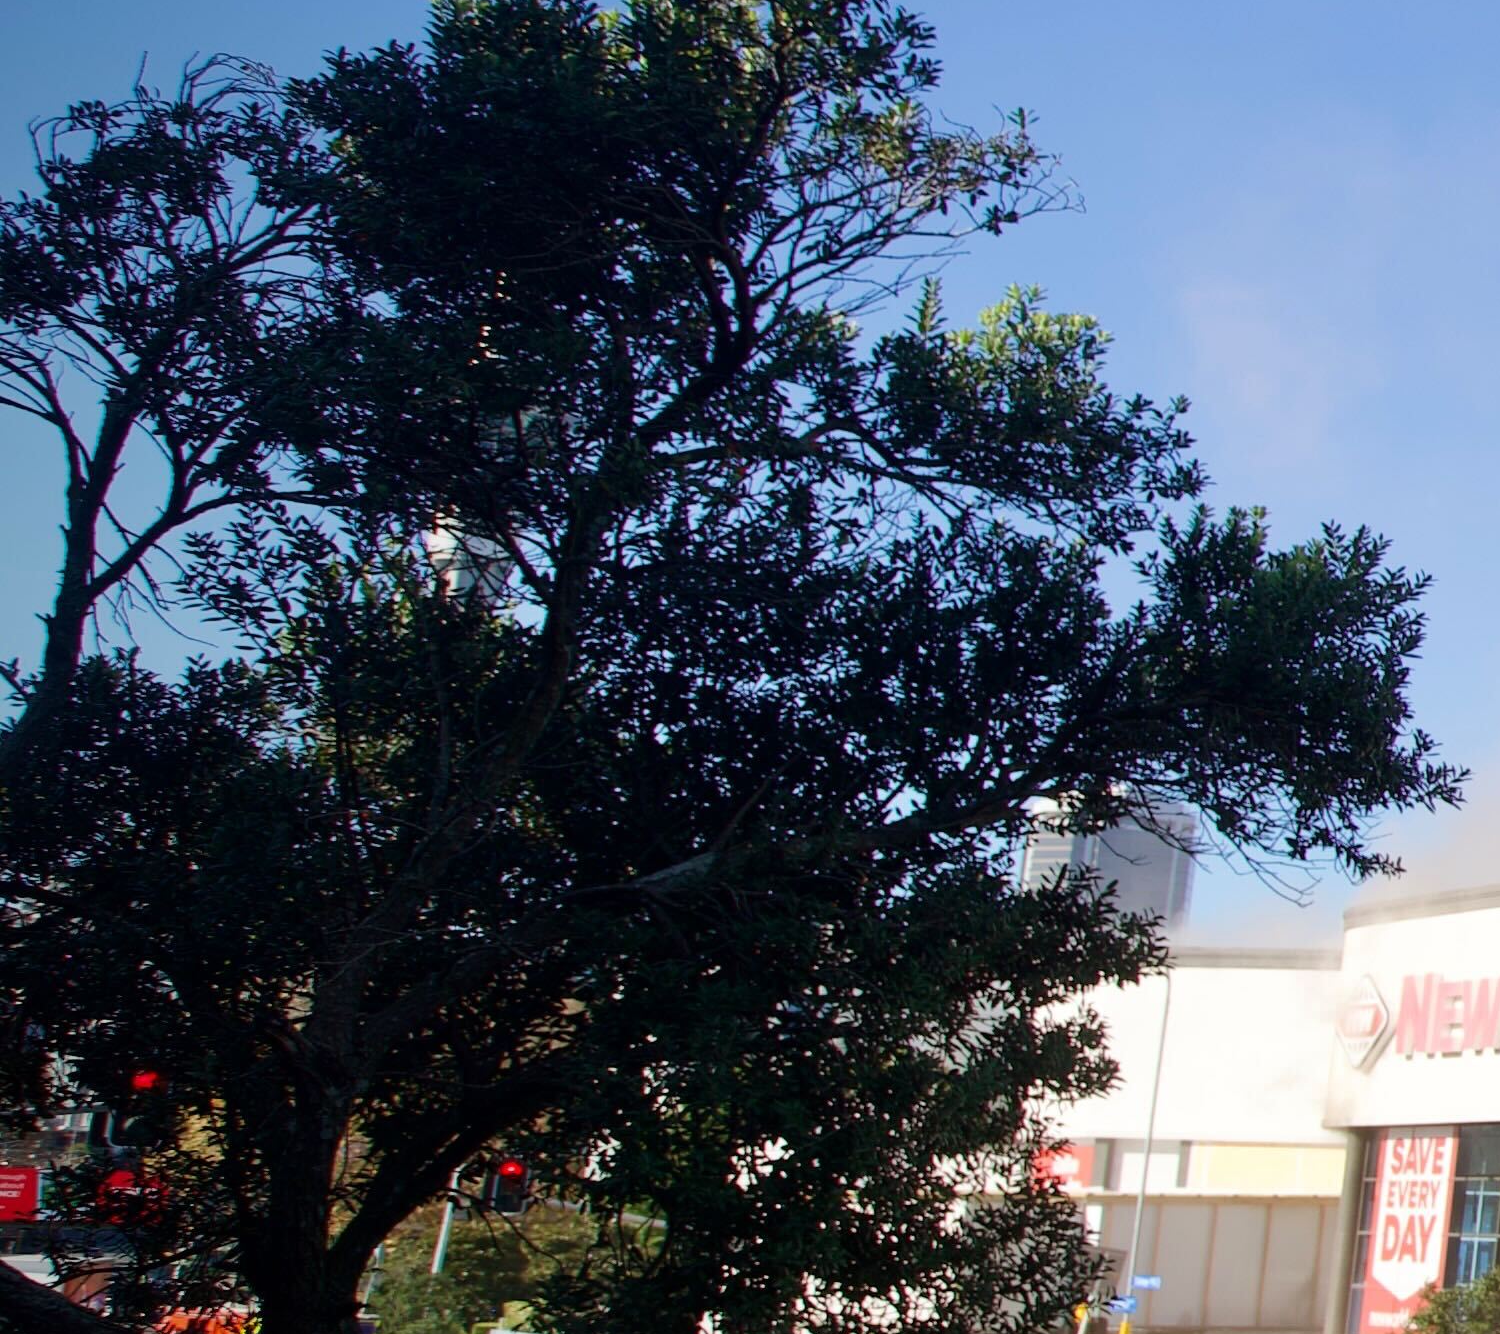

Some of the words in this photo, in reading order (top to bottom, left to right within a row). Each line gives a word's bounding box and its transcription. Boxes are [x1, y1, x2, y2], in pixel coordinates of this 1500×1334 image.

[1390, 1136, 1446, 1175] SAVE
[1386, 1180, 1441, 1209] EVERY
[1381, 1215, 1437, 1264] DAY
